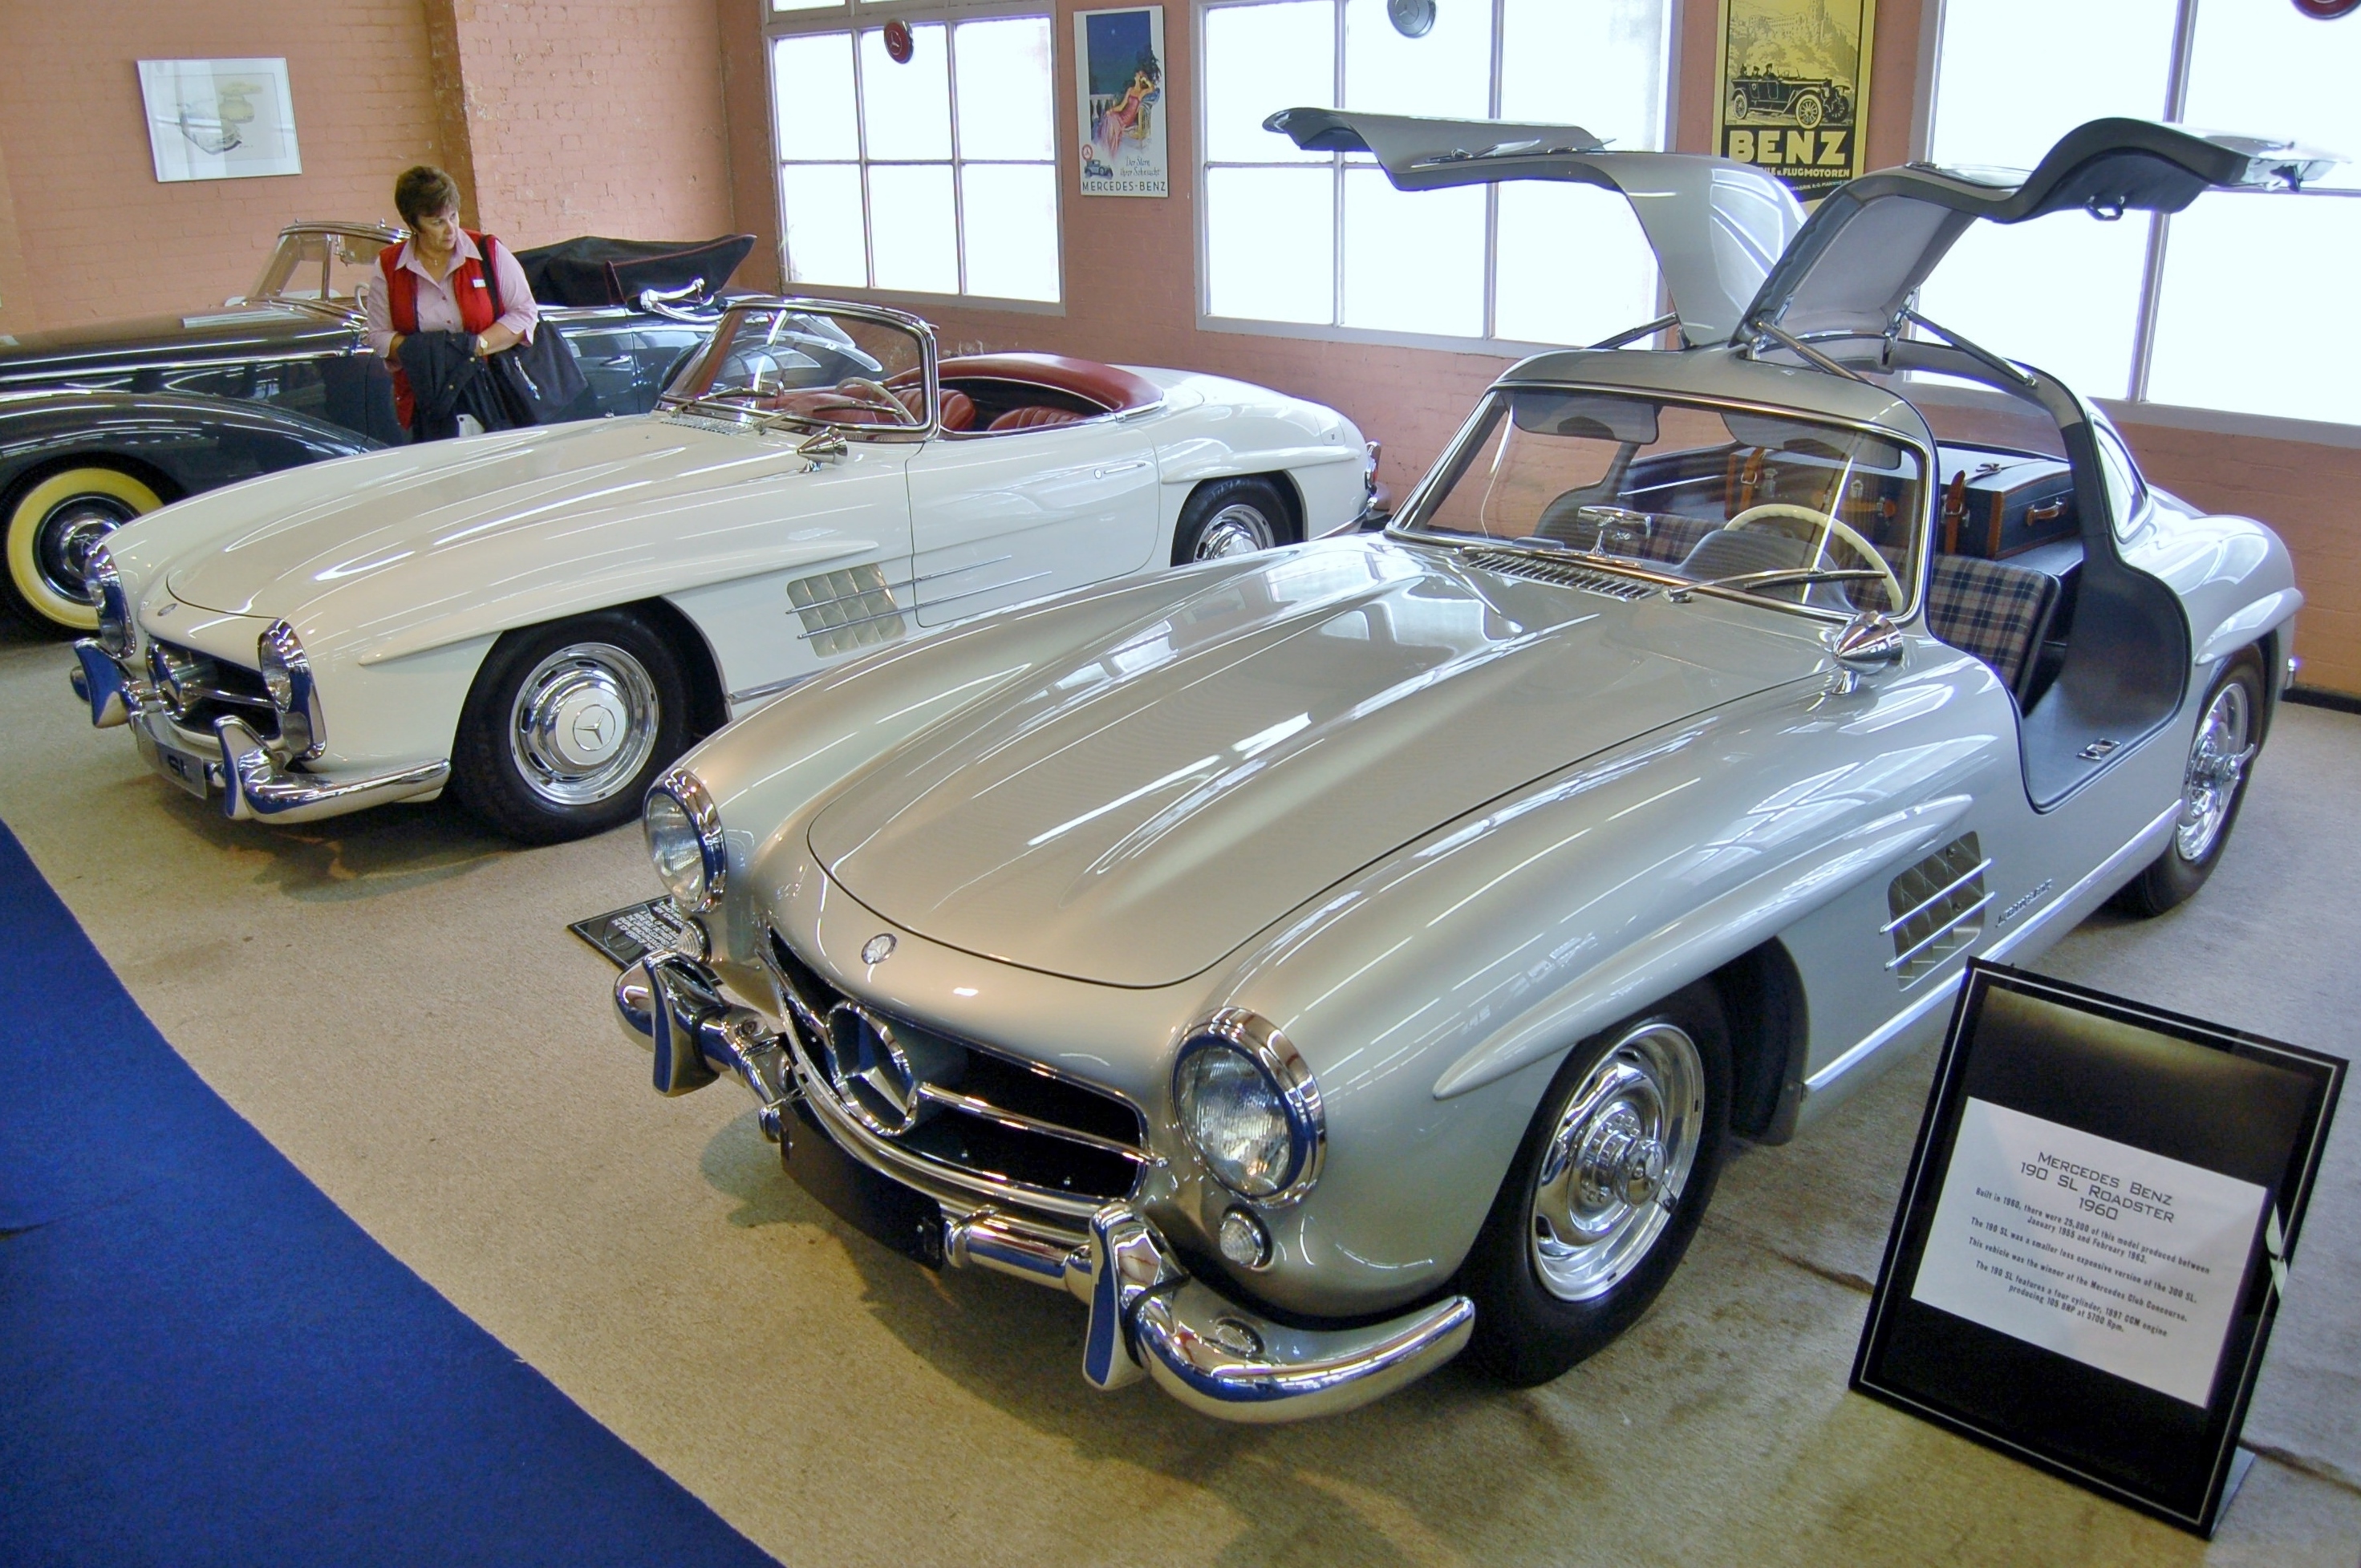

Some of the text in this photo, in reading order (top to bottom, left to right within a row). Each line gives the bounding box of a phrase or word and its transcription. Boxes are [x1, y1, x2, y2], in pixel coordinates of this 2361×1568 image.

[1729, 130, 1847, 165] BENZ
[1082, 181, 1166, 192] MERCEDES-BENZ
[1783, 168, 1850, 177] FLUGMOTOREN
[2020, 1161, 2175, 1224] 190 SL ROADSTER
[2037, 1151, 2173, 1206] MERCEDES BENZ
[1975, 1187, 1993, 1200] Built
[1994, 1193, 2001, 1202] in
[2023, 1204, 2043, 1218] there
[2045, 1212, 2062, 1224] were
[2091, 1228, 2099, 1236] of
[2100, 1230, 2115, 1242] this
[2116, 1238, 2140, 1250] model
[2140, 1246, 2176, 1263] produced
[2177, 1256, 2210, 1274] between
[2079, 1197, 2119, 1221] 1960
[1971, 1216, 1983, 1228] The
[1986, 1222, 1998, 1233] 190
[1999, 1226, 2008, 1238] SL
[2010, 1232, 2023, 1242] was
[2031, 1240, 2059, 1254] smaller
[2059, 1248, 2075, 1260] less
[2076, 1256, 2112, 1274] expensive
[2115, 1269, 2141, 1284] version
[2143, 1278, 2152, 1287] of
[2153, 1281, 2166, 1292] the
[2026, 1216, 2056, 1234] January
[2076, 1234, 2091, 1244] and
[2092, 1238, 2125, 1258] February
[1969, 1236, 1983, 1249] This
[1985, 1244, 2010, 1258] vehicle
[2011, 1254, 2025, 1264] was
[2026, 1258, 2038, 1269] the
[2040, 1264, 2065, 1278] winner
[2066, 1274, 2075, 1282] at
[2075, 1275, 2088, 1286] the
[2090, 1279, 2125, 1300] Mercedes
[2128, 1293, 2144, 1307] Club
[1976, 1259, 1989, 1271] The
[1990, 1266, 2003, 1277] 190
[2004, 1270, 2013, 1281] SL
[2015, 1274, 2045, 1293] features
[2054, 1289, 2070, 1301] four
[2142, 1323, 2168, 1337] engine
[2008, 1285, 2045, 1305] producing
[2076, 1310, 2086, 1318] at
[2087, 1311, 2105, 1325] 5700
